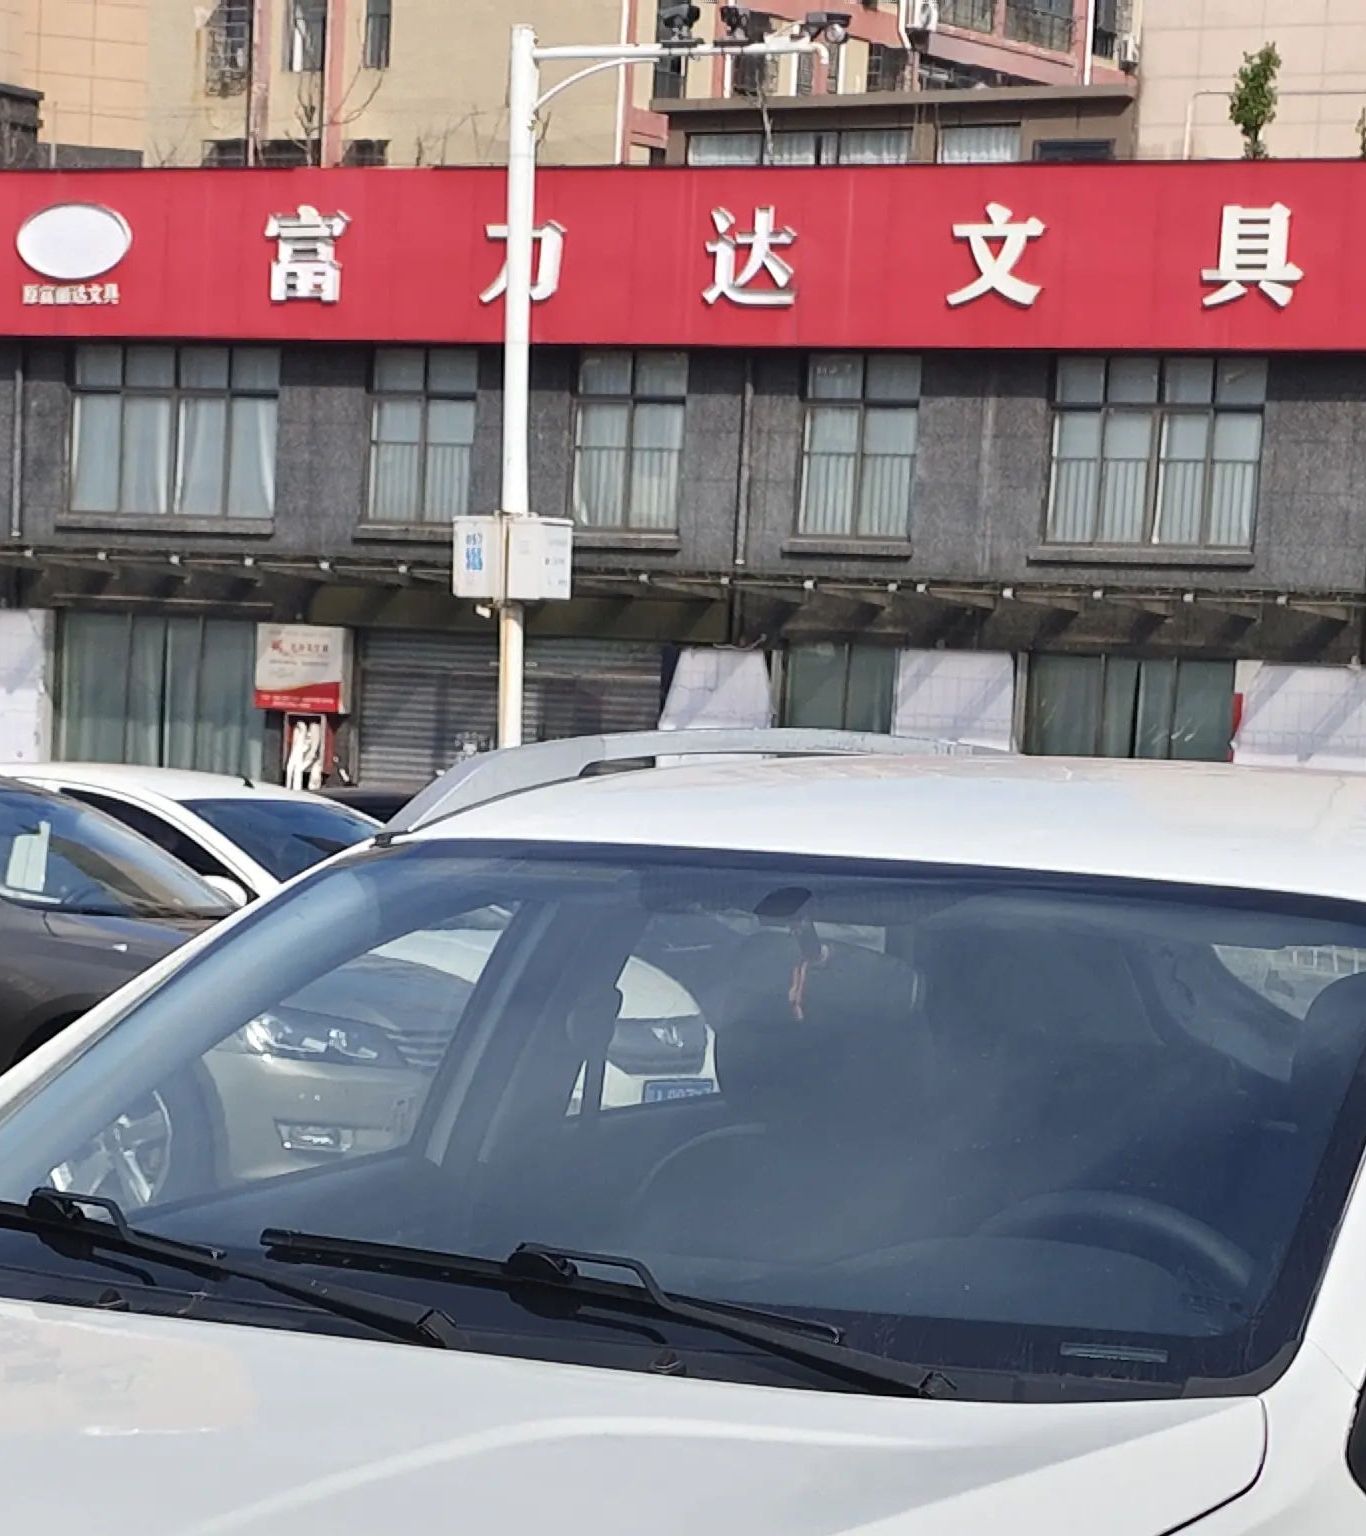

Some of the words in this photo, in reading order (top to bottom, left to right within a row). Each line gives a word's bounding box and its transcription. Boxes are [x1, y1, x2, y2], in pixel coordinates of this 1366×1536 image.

[264, 203, 1305, 307] 富力达文具
